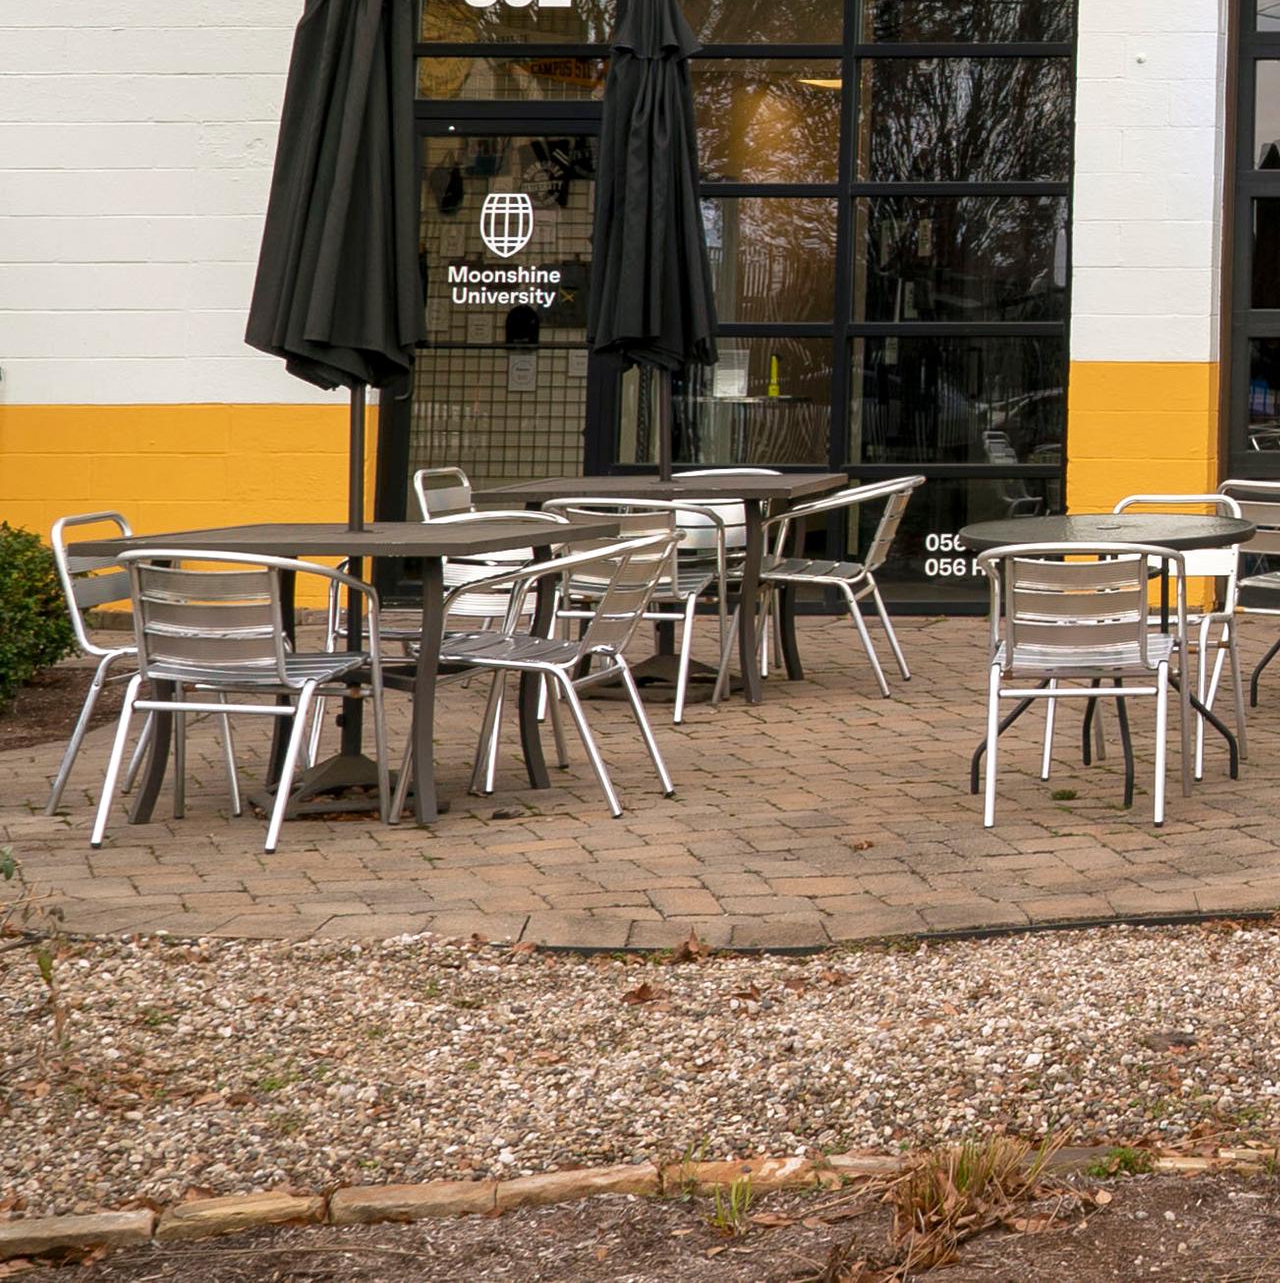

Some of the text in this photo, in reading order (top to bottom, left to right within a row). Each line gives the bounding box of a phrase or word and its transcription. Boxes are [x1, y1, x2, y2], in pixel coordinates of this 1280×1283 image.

[530, 60, 573, 77] CAMPUS
[447, 265, 561, 284] Moonshine
[451, 284, 557, 310] University
[925, 533, 967, 552] 056
[924, 557, 967, 577] 056
